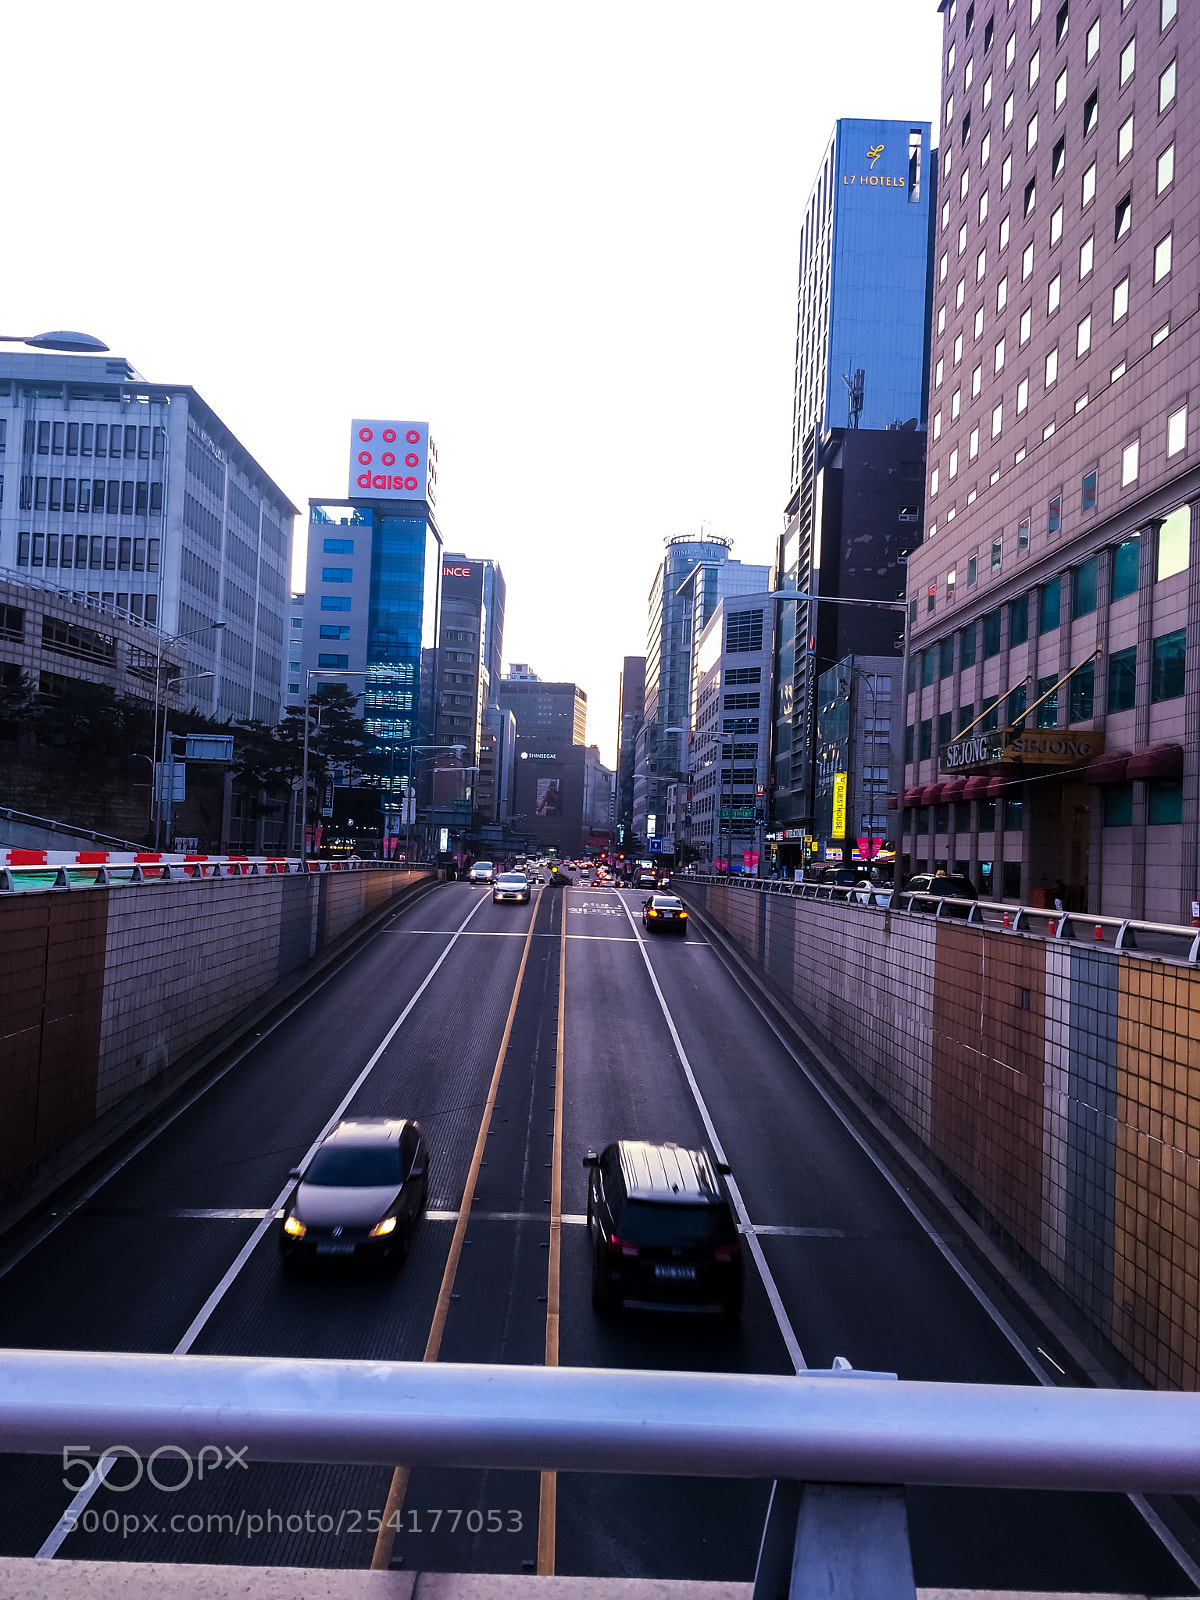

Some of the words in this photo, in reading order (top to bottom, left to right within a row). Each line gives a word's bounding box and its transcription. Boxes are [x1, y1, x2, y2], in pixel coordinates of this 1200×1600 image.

[843, 175, 856, 186] L7
[860, 176, 905, 188] HOTELS
[357, 470, 418, 491] daiso
[442, 567, 471, 577] INCE
[528, 752, 557, 760] SHINSEGAE
[946, 737, 988, 769] SEJONG
[1012, 738, 1092, 757] SEJONG
[835, 785, 845, 830] GUESTHOUSE
